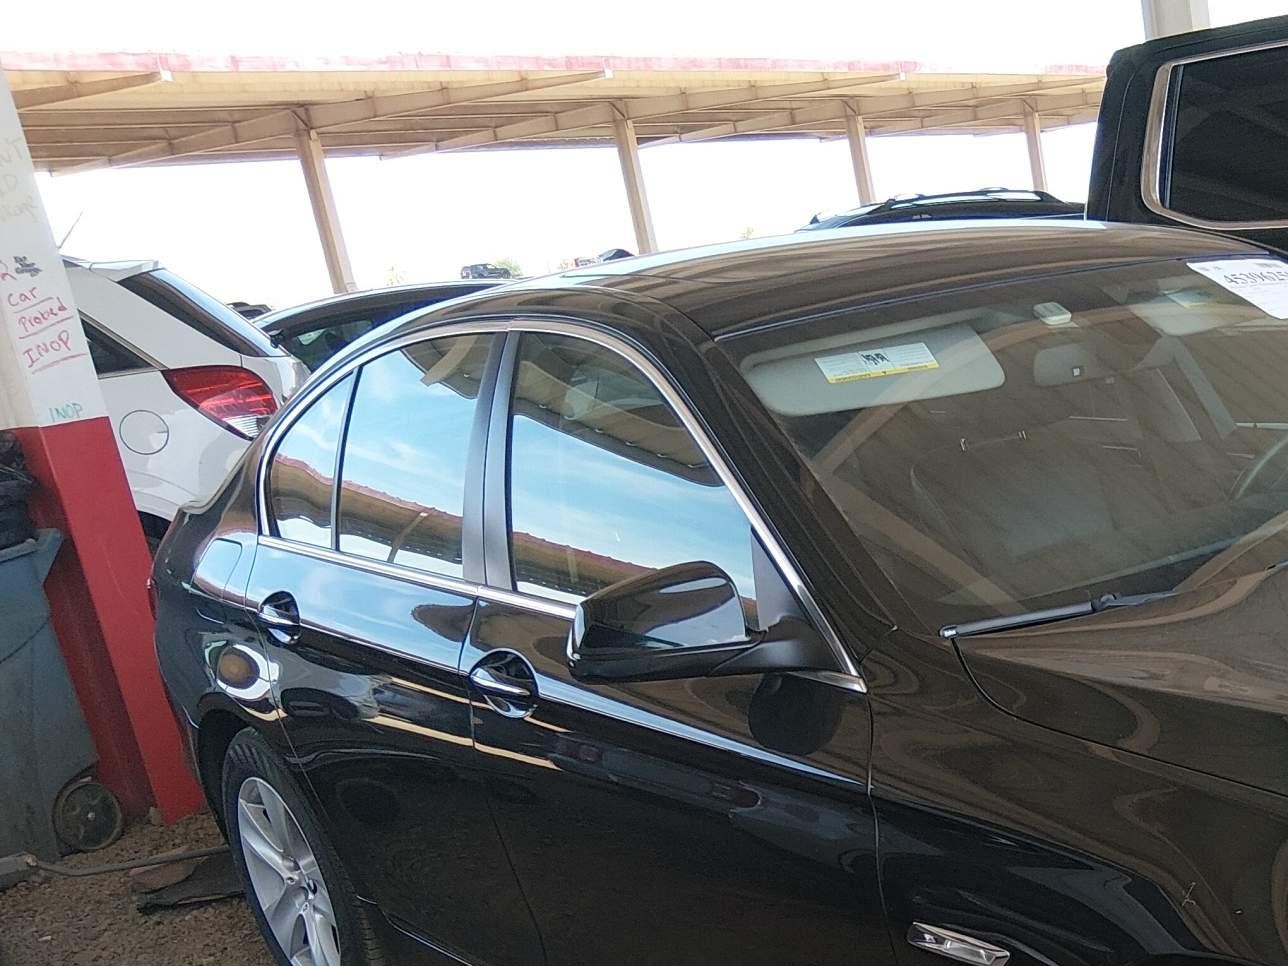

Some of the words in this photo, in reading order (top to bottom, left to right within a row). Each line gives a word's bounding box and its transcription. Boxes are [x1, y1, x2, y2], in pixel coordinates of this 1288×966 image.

[7, 287, 38, 307] Car
[23, 329, 71, 368] INOP
[48, 402, 84, 422] INOP
